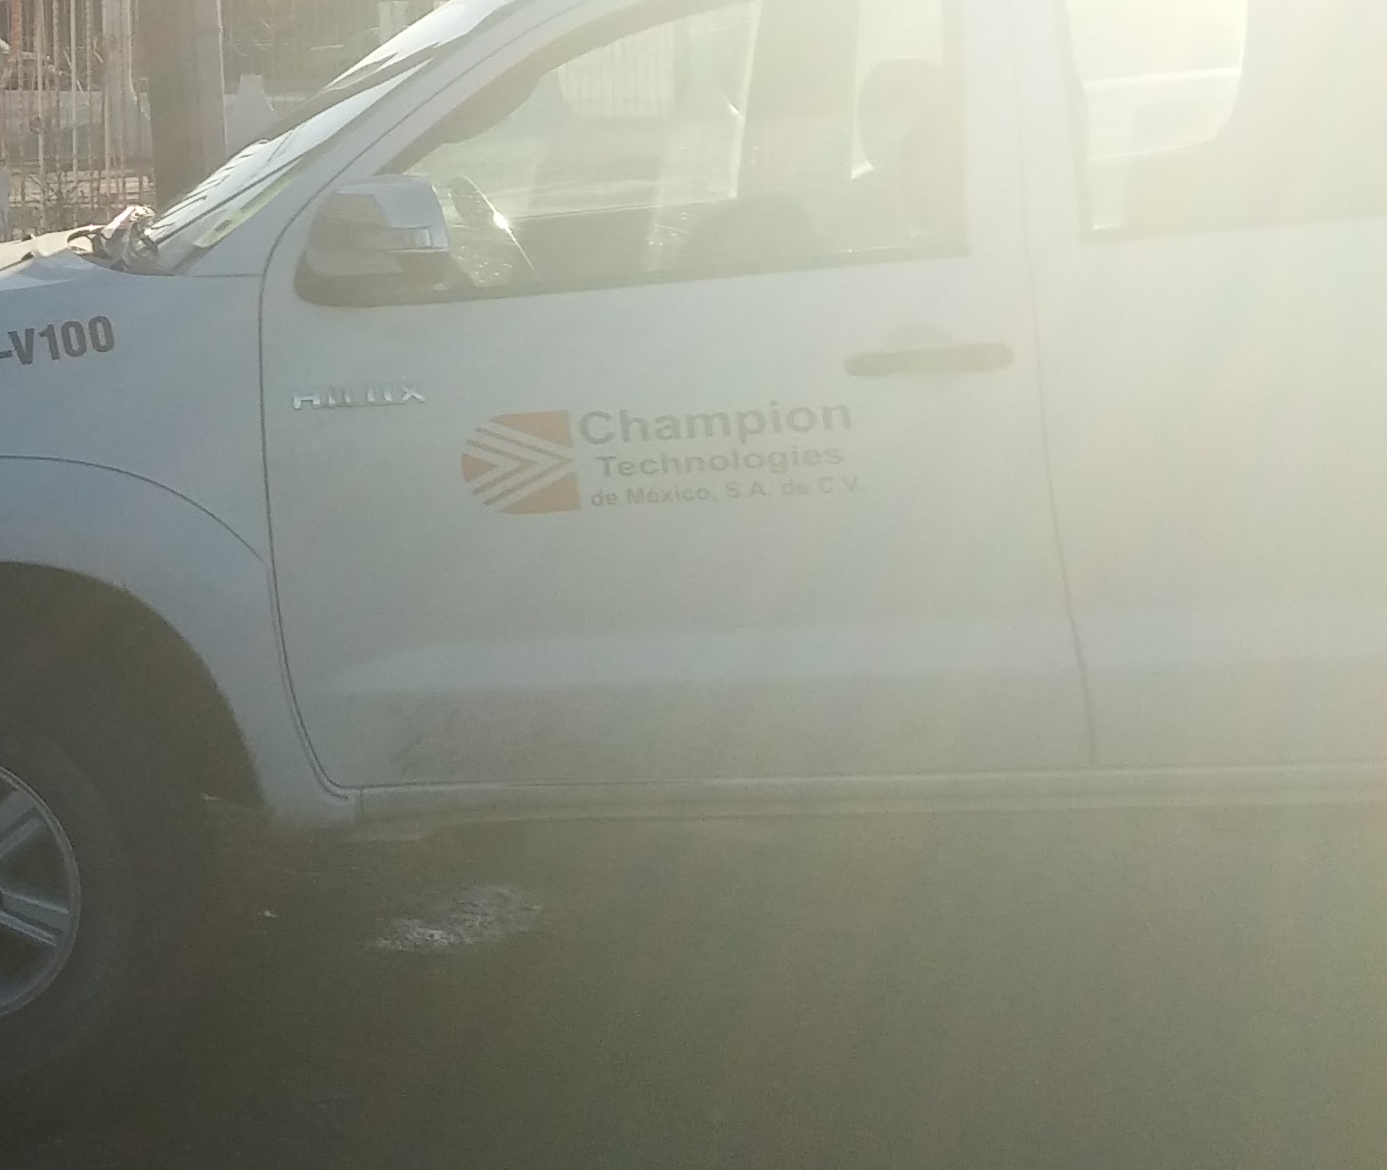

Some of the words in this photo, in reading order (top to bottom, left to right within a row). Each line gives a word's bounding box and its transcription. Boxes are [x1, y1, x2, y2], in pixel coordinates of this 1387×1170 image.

[579, 399, 852, 445] Champion
[595, 445, 845, 477] Technologies
[590, 487, 618, 507] de
